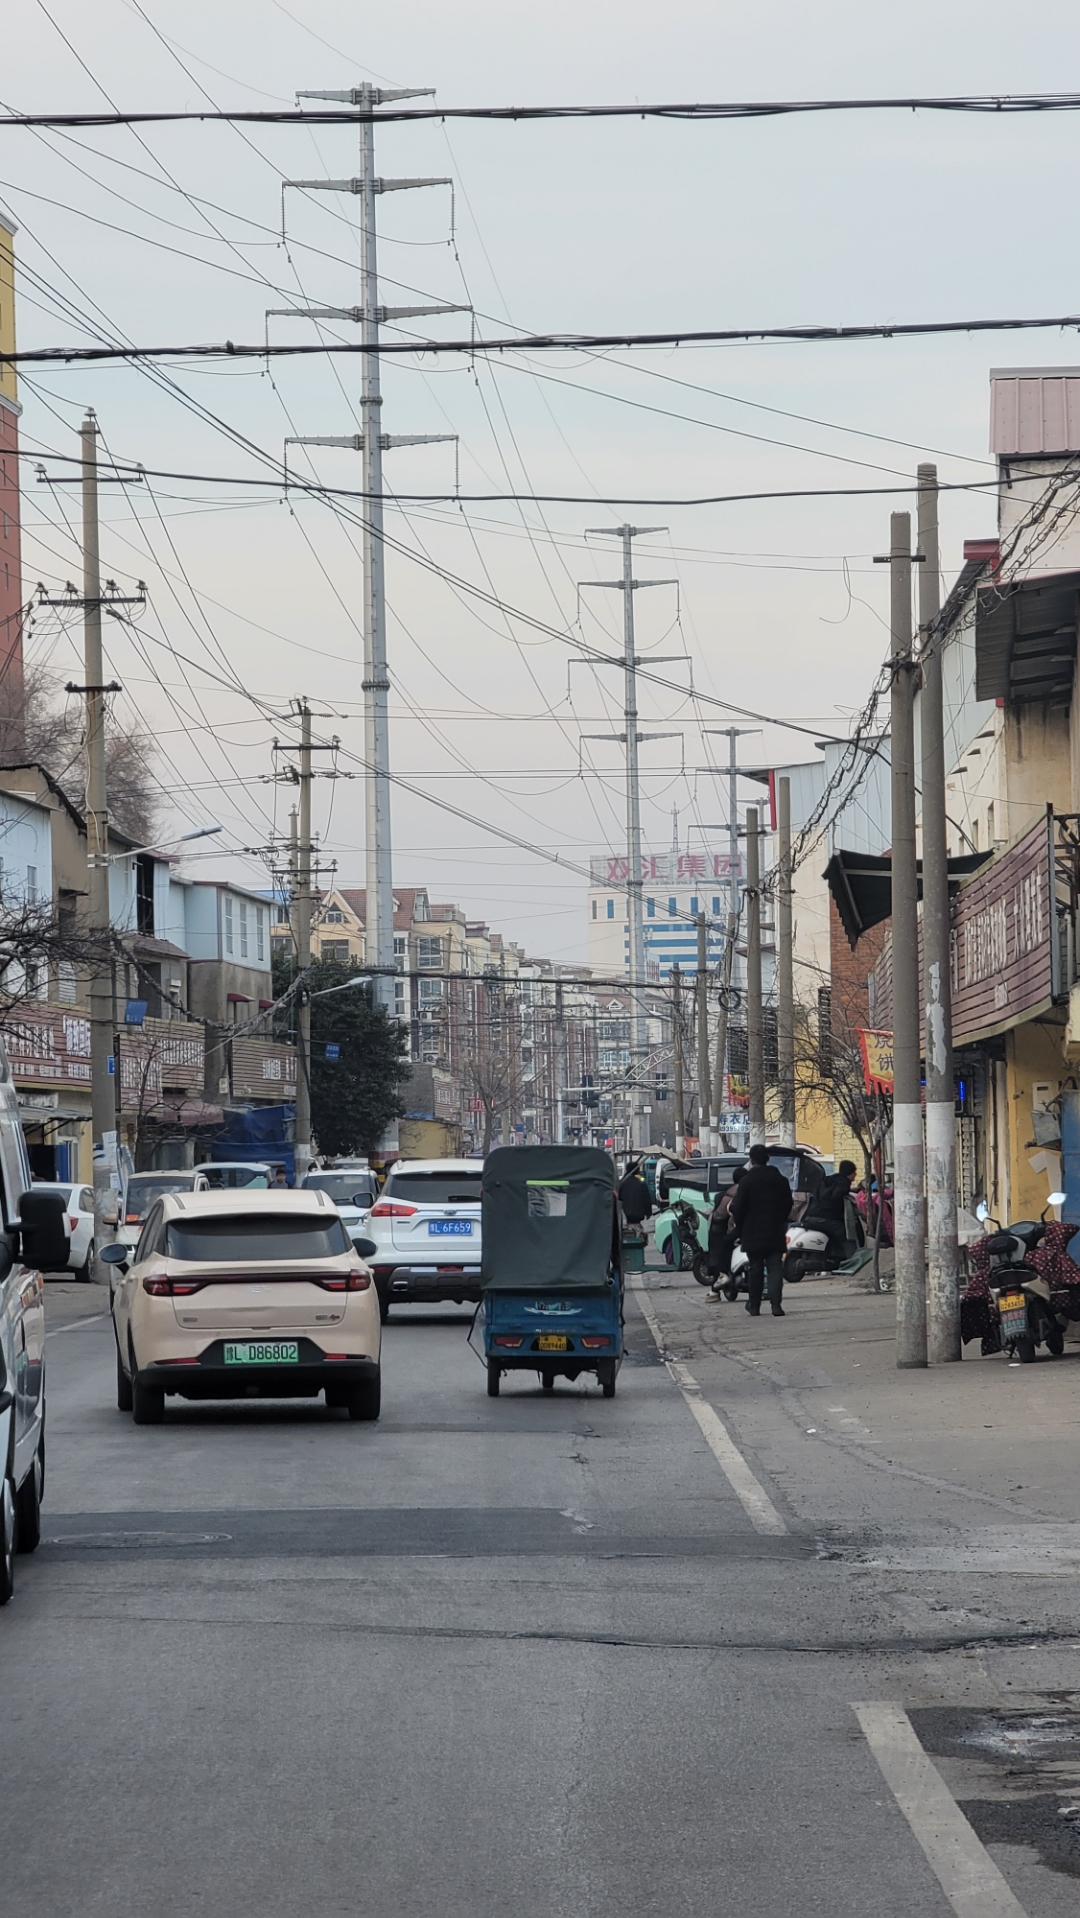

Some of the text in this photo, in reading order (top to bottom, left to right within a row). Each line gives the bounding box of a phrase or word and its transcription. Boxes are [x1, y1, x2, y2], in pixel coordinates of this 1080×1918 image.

[606, 854, 742, 880] 双汇集团
[874, 1034, 894, 1071] 烧饼
